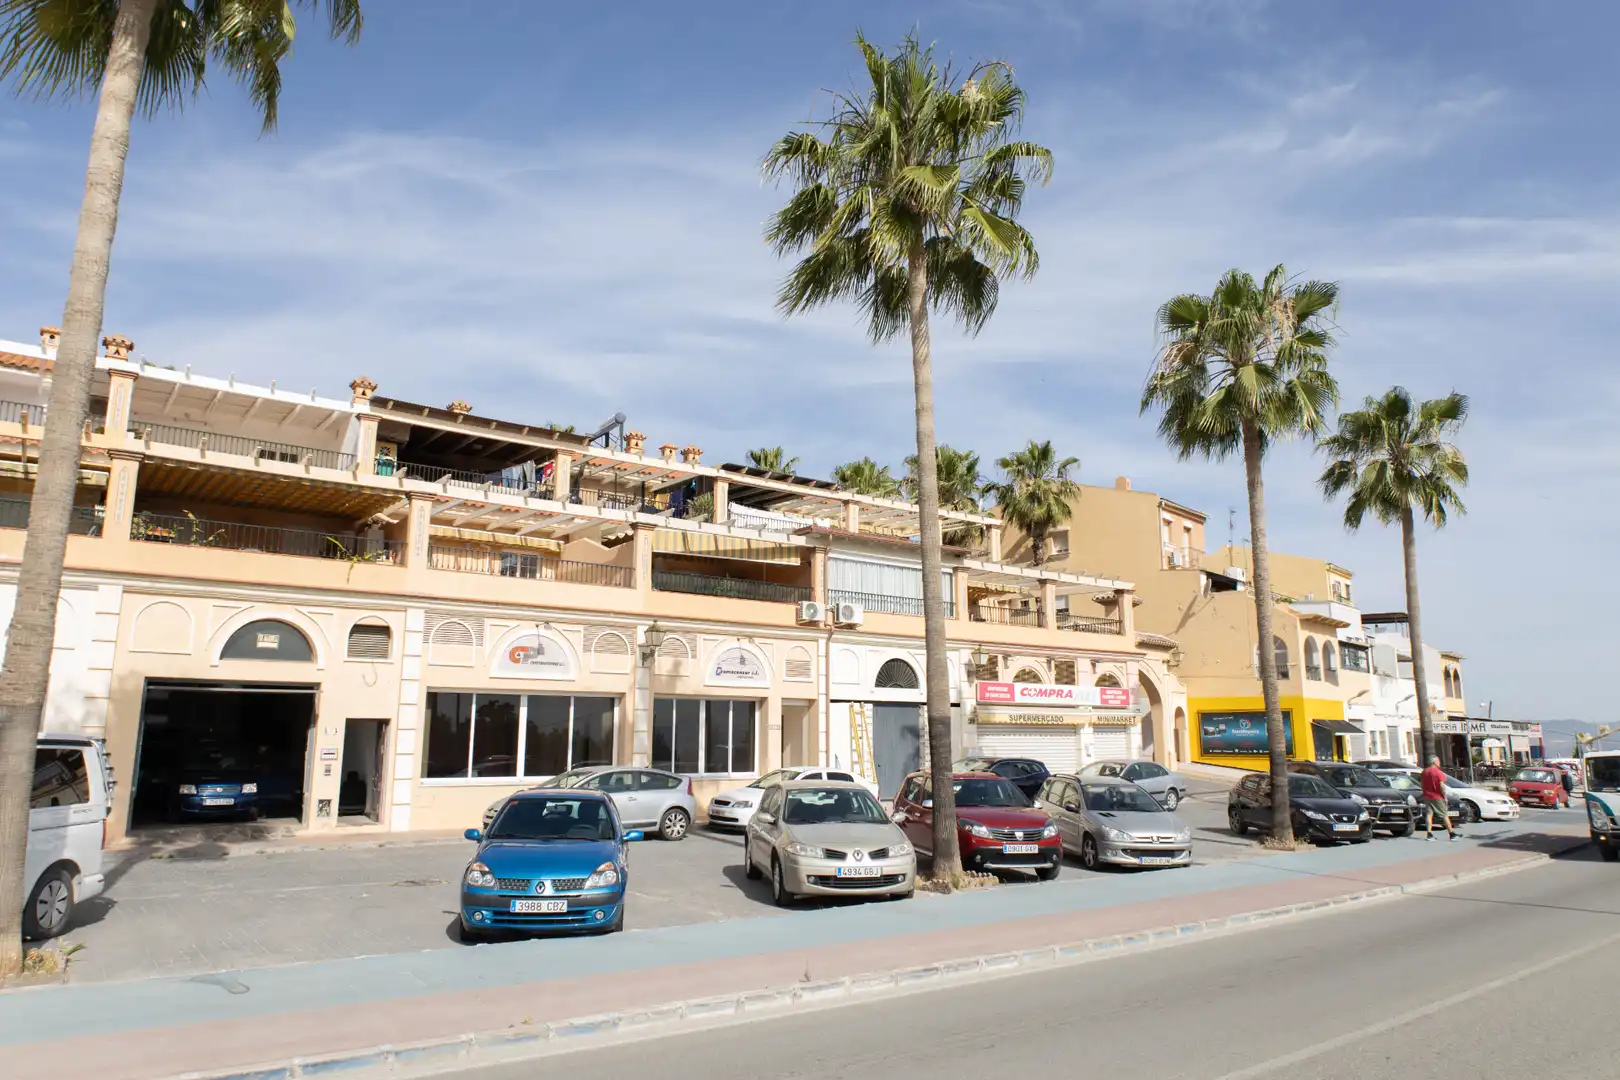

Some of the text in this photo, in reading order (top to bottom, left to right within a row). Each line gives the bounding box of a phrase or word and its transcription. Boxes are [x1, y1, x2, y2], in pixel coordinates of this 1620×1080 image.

[1020, 687, 1073, 699] COMPRA
[1009, 714, 1064, 723] SUPERMERCADO
[1097, 715, 1137, 723] MINIMARKET
[1432, 723, 1457, 731] APERIA
[843, 867, 879, 876] 4934 GBJ
[518, 901, 565, 911] 3988 CBZ
